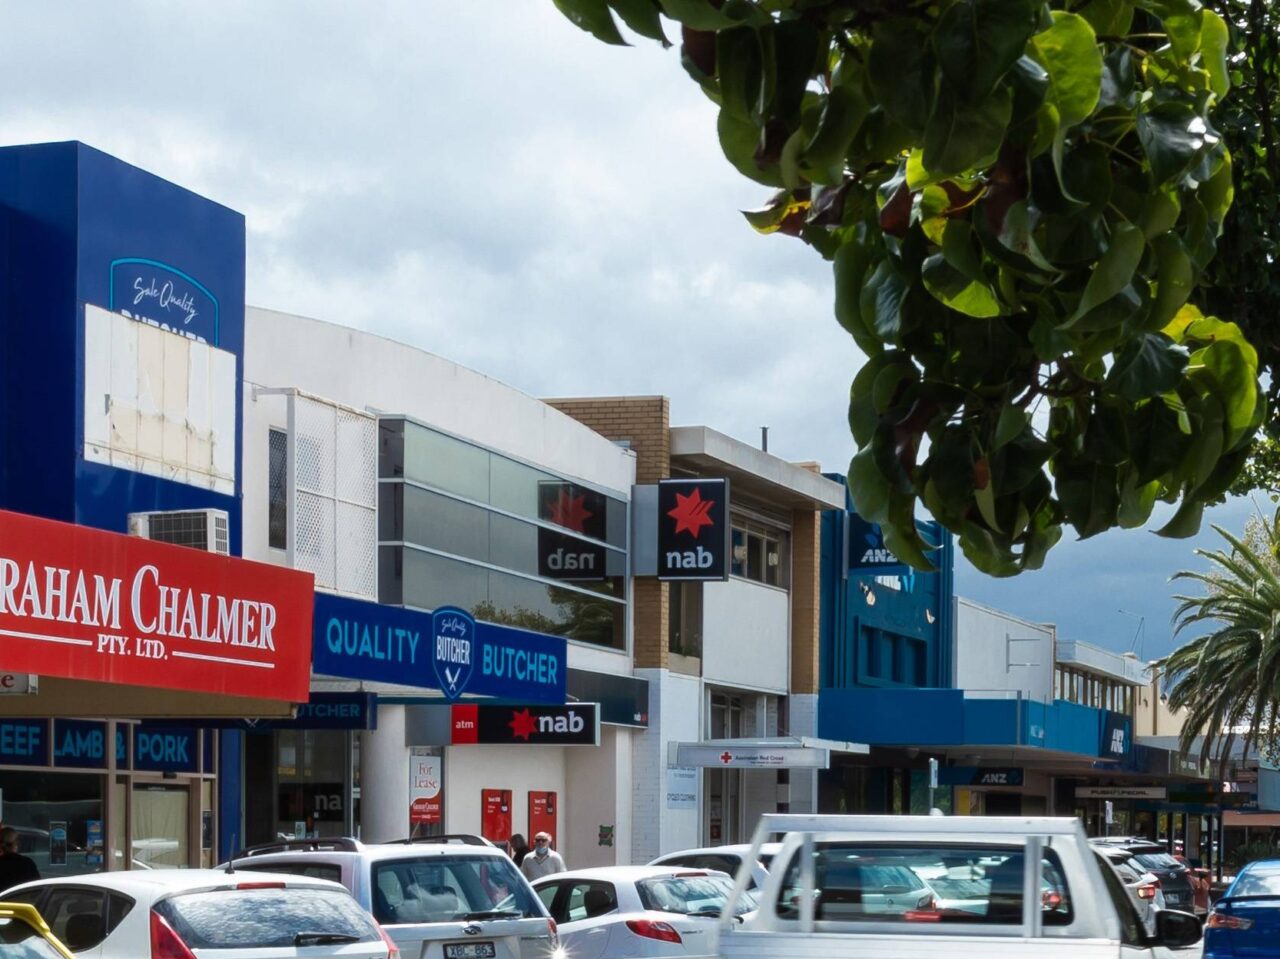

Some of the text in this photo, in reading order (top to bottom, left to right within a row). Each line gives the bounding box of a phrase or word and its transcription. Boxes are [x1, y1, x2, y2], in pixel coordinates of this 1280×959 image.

[133, 277, 198, 324] Sale Quality
[666, 546, 713, 569] nab
[860, 549, 898, 563] ANZ
[131, 564, 277, 652] CHALMER
[96, 633, 168, 660] PTY. LTD.
[326, 617, 420, 664] QUALITY
[436, 635, 470, 665] BUTCHER
[482, 643, 558, 685] BUTCHER
[297, 703, 360, 718] UTCHER
[538, 710, 584, 733] nab
[455, 720, 474, 729] atm
[52, 728, 103, 759] LAMB
[137, 733, 190, 763] PORK
[418, 763, 433, 776] For
[981, 773, 1008, 784] ANZ
[414, 776, 438, 789] Lease
